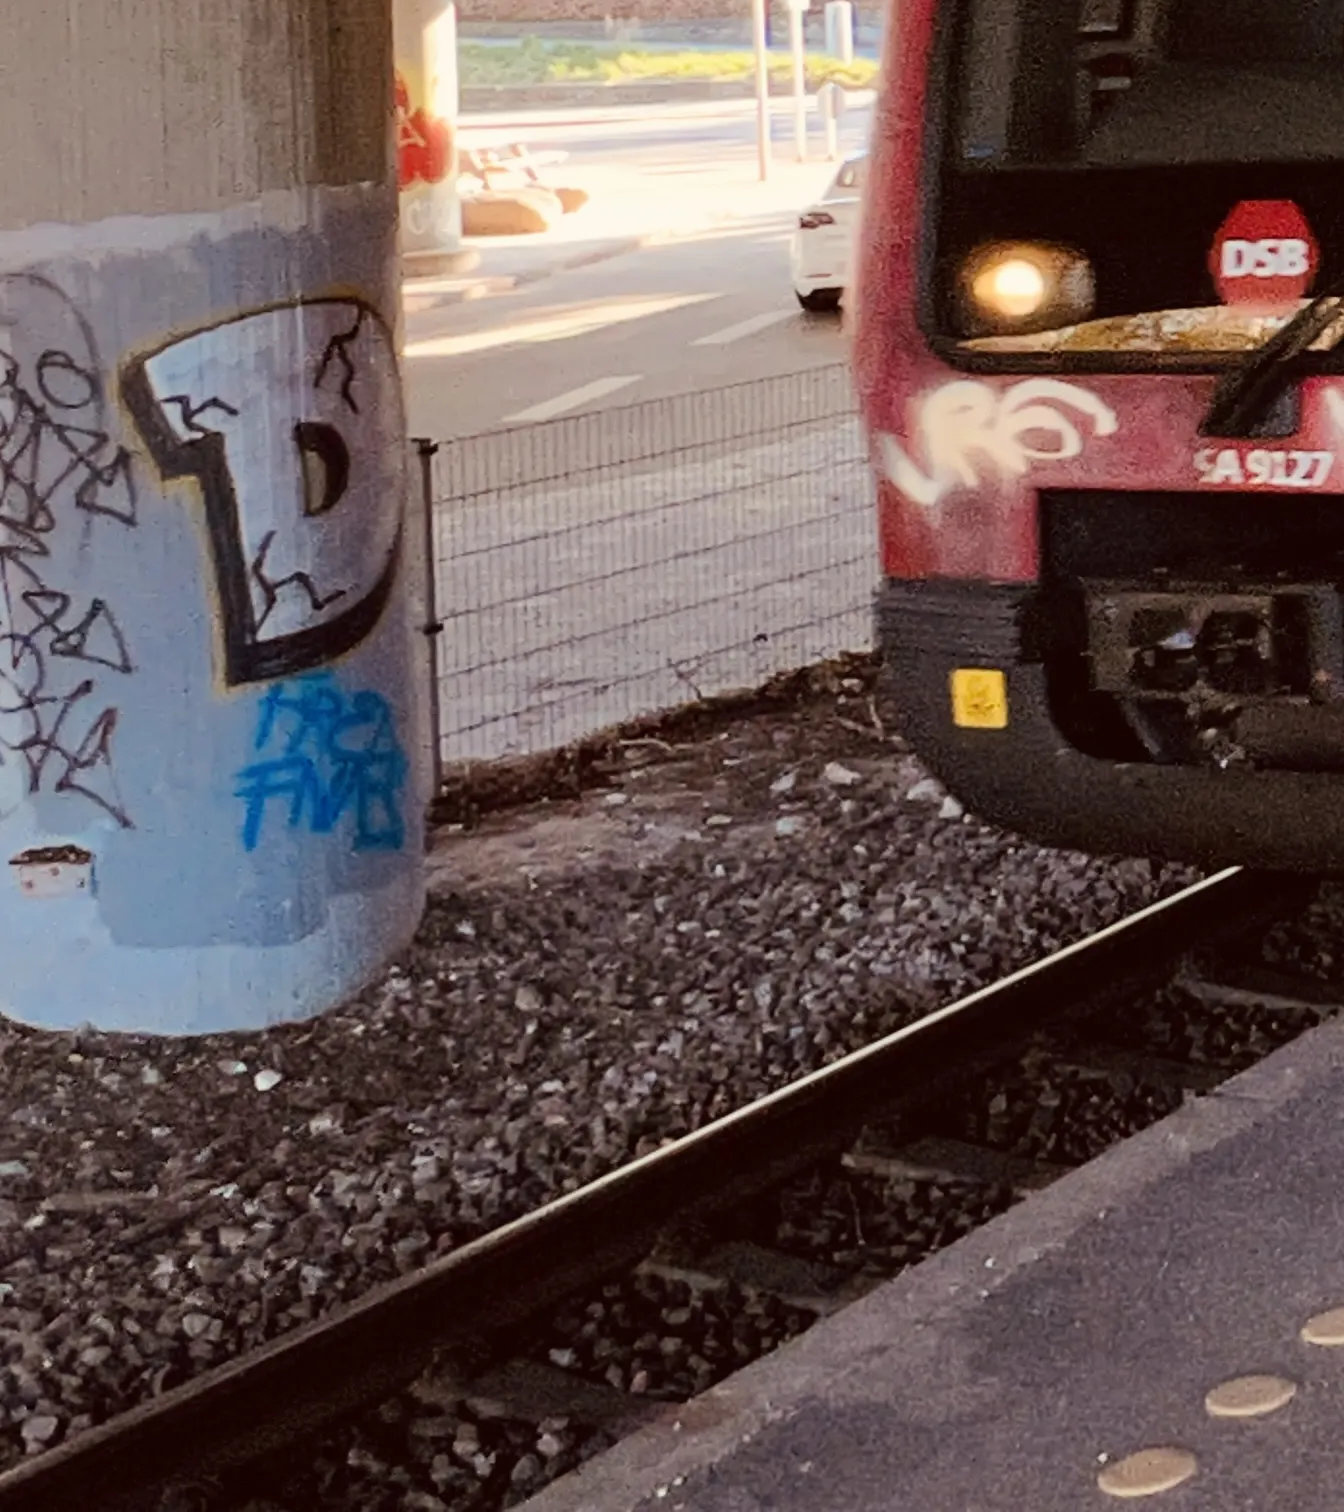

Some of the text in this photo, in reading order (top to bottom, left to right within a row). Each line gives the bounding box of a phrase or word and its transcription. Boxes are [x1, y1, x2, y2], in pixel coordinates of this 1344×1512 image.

[1221, 239, 1309, 278] DSB
[1193, 448, 1334, 487] SA 9127
